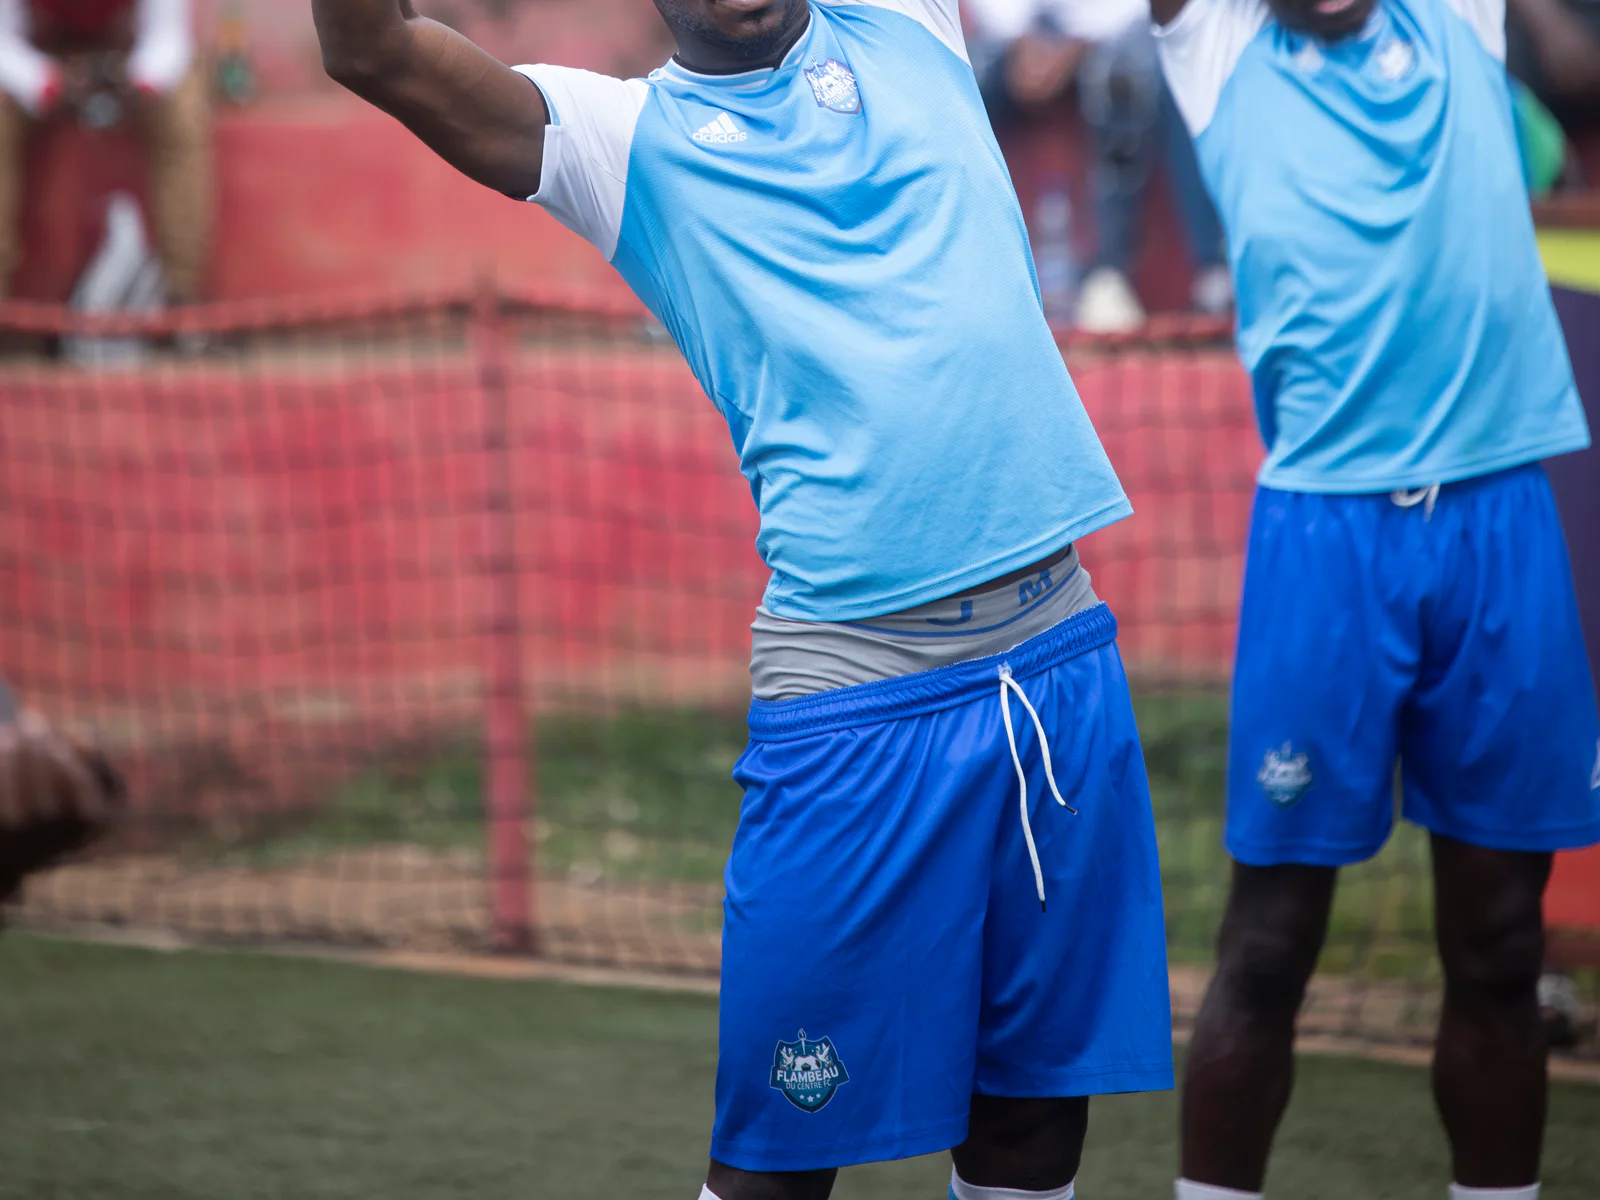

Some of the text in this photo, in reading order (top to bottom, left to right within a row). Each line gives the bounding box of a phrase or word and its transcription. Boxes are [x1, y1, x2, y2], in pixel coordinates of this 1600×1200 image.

[815, 72, 855, 102] FLAMBEAU
[692, 131, 748, 143] adidas
[777, 1065, 839, 1082] FLAMBEAU
[786, 1079, 832, 1090] DU CENTRE FC
